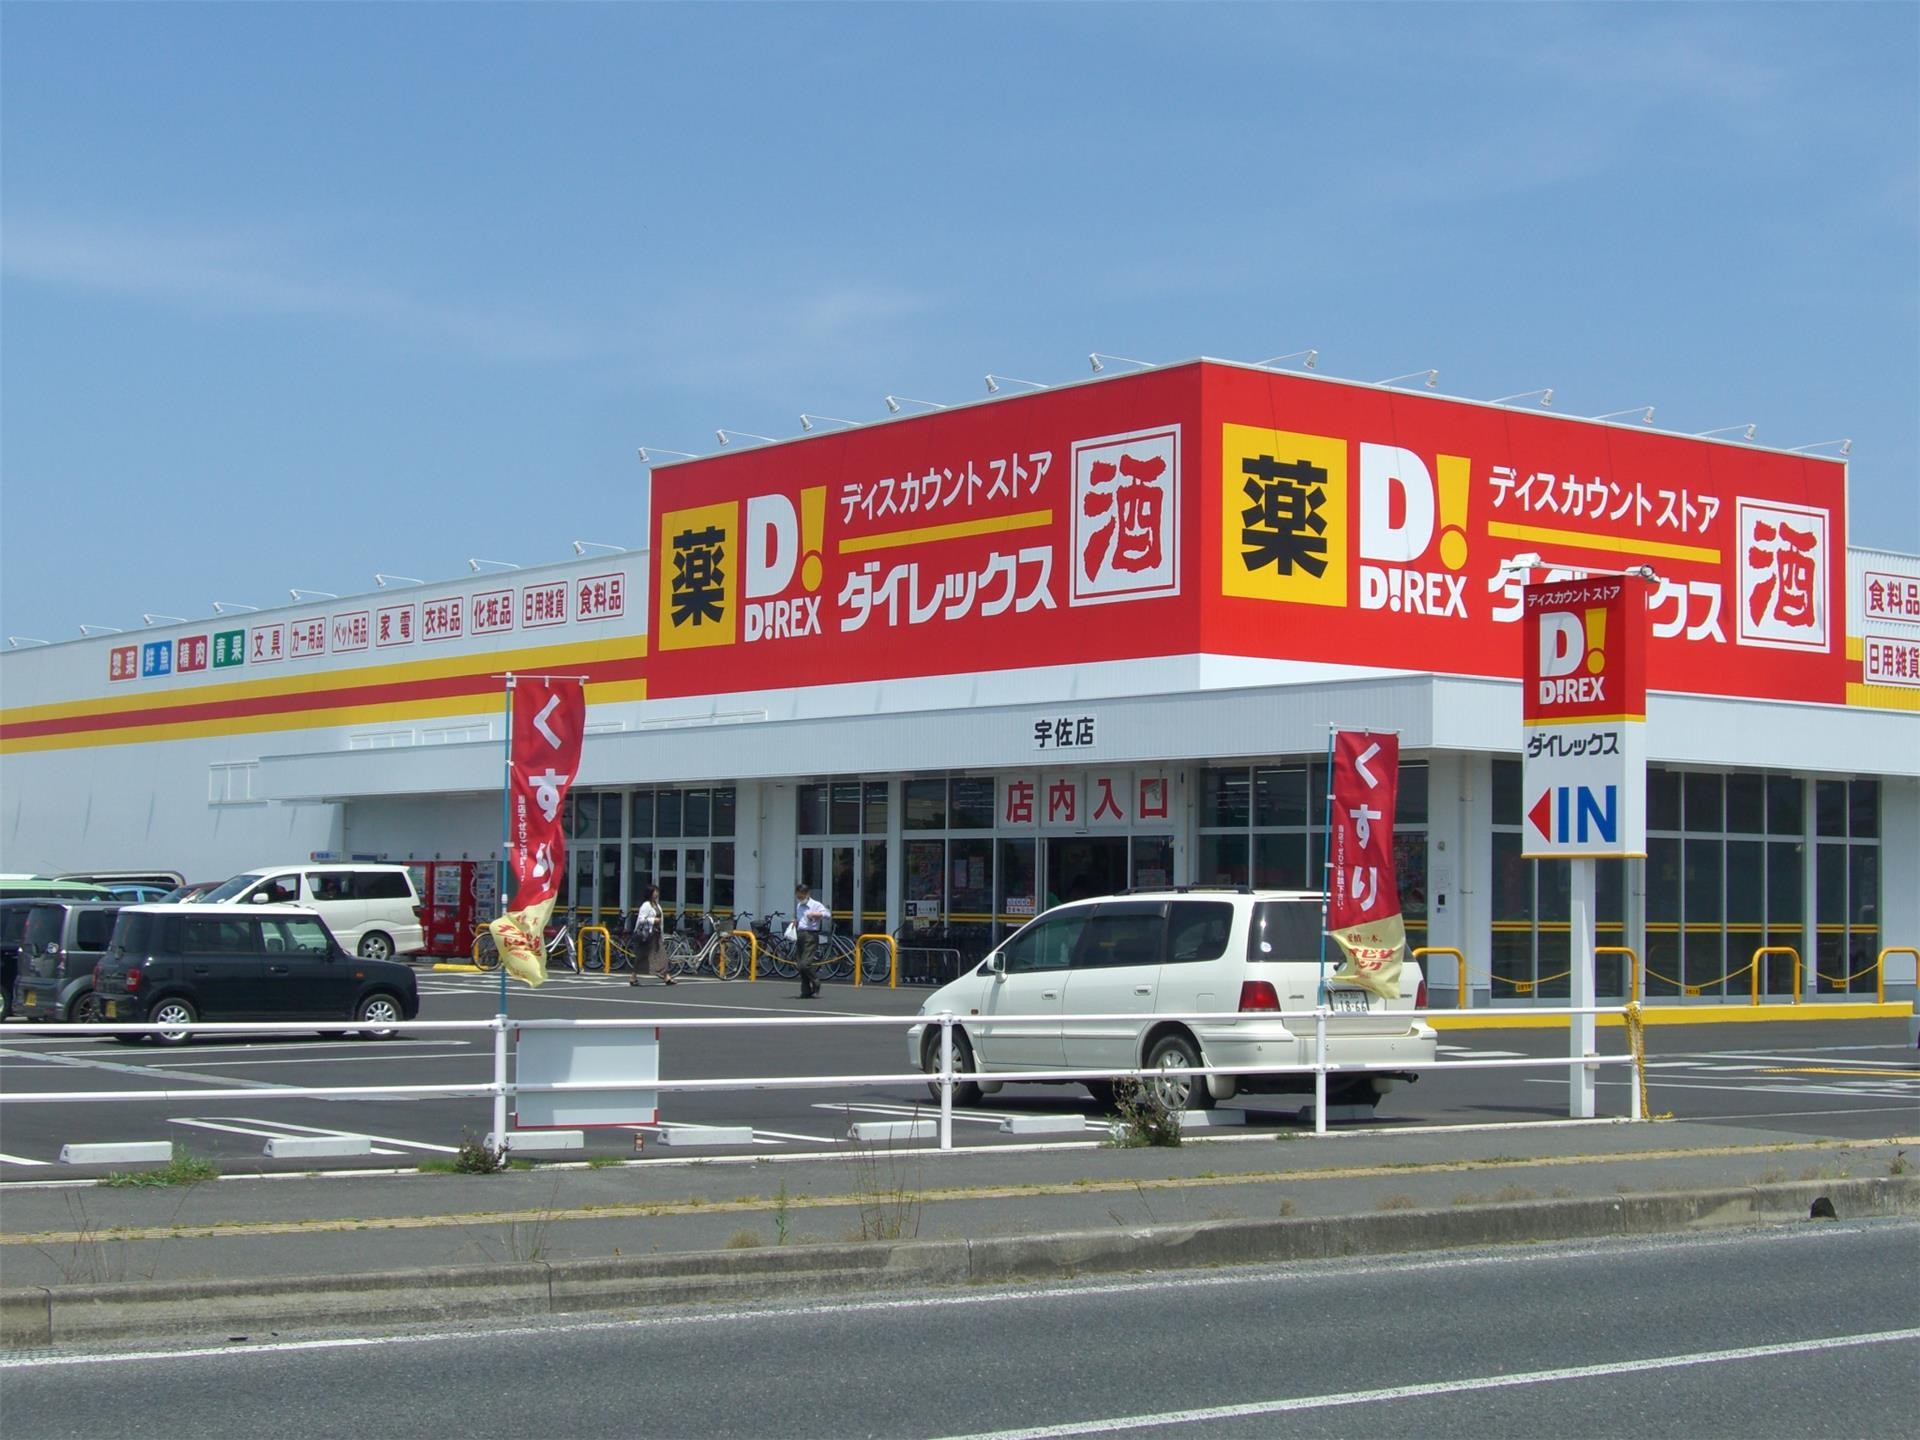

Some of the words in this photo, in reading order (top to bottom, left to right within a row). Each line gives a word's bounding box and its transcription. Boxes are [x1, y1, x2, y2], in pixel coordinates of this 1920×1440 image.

[1082, 454, 1168, 584] 酒
[1241, 454, 1329, 577] 薬
[671, 526, 726, 629] 薬
[838, 545, 1058, 633] ダイレックス
[1360, 565, 1469, 619] D!REX
[1748, 520, 1818, 629] 酒
[473, 596, 512, 629] 化粧品
[525, 588, 565, 621] 日用雑貨
[579, 580, 622, 615] 食料品
[1869, 579, 1920, 616] 食料品
[334, 617, 367, 646] ペット用品
[380, 611, 411, 641] 家電
[425, 603, 460, 635] 衣料品
[744, 595, 823, 643] D!REX
[180, 640, 205, 668] 精肉
[216, 635, 242, 663] 青果
[254, 630, 281, 657] 文具
[292, 623, 323, 652] カー用品
[1869, 643, 1920, 678] 日用雑貨
[1539, 676, 1605, 705] D!REX
[1034, 717, 1095, 748] 宇佐店
[1528, 732, 1620, 758] ダイレックス
[528, 693, 570, 893] くすり
[1006, 778, 1168, 823] 店内入口
[1348, 742, 1382, 912] くすり
[1558, 785, 1617, 843] IN
